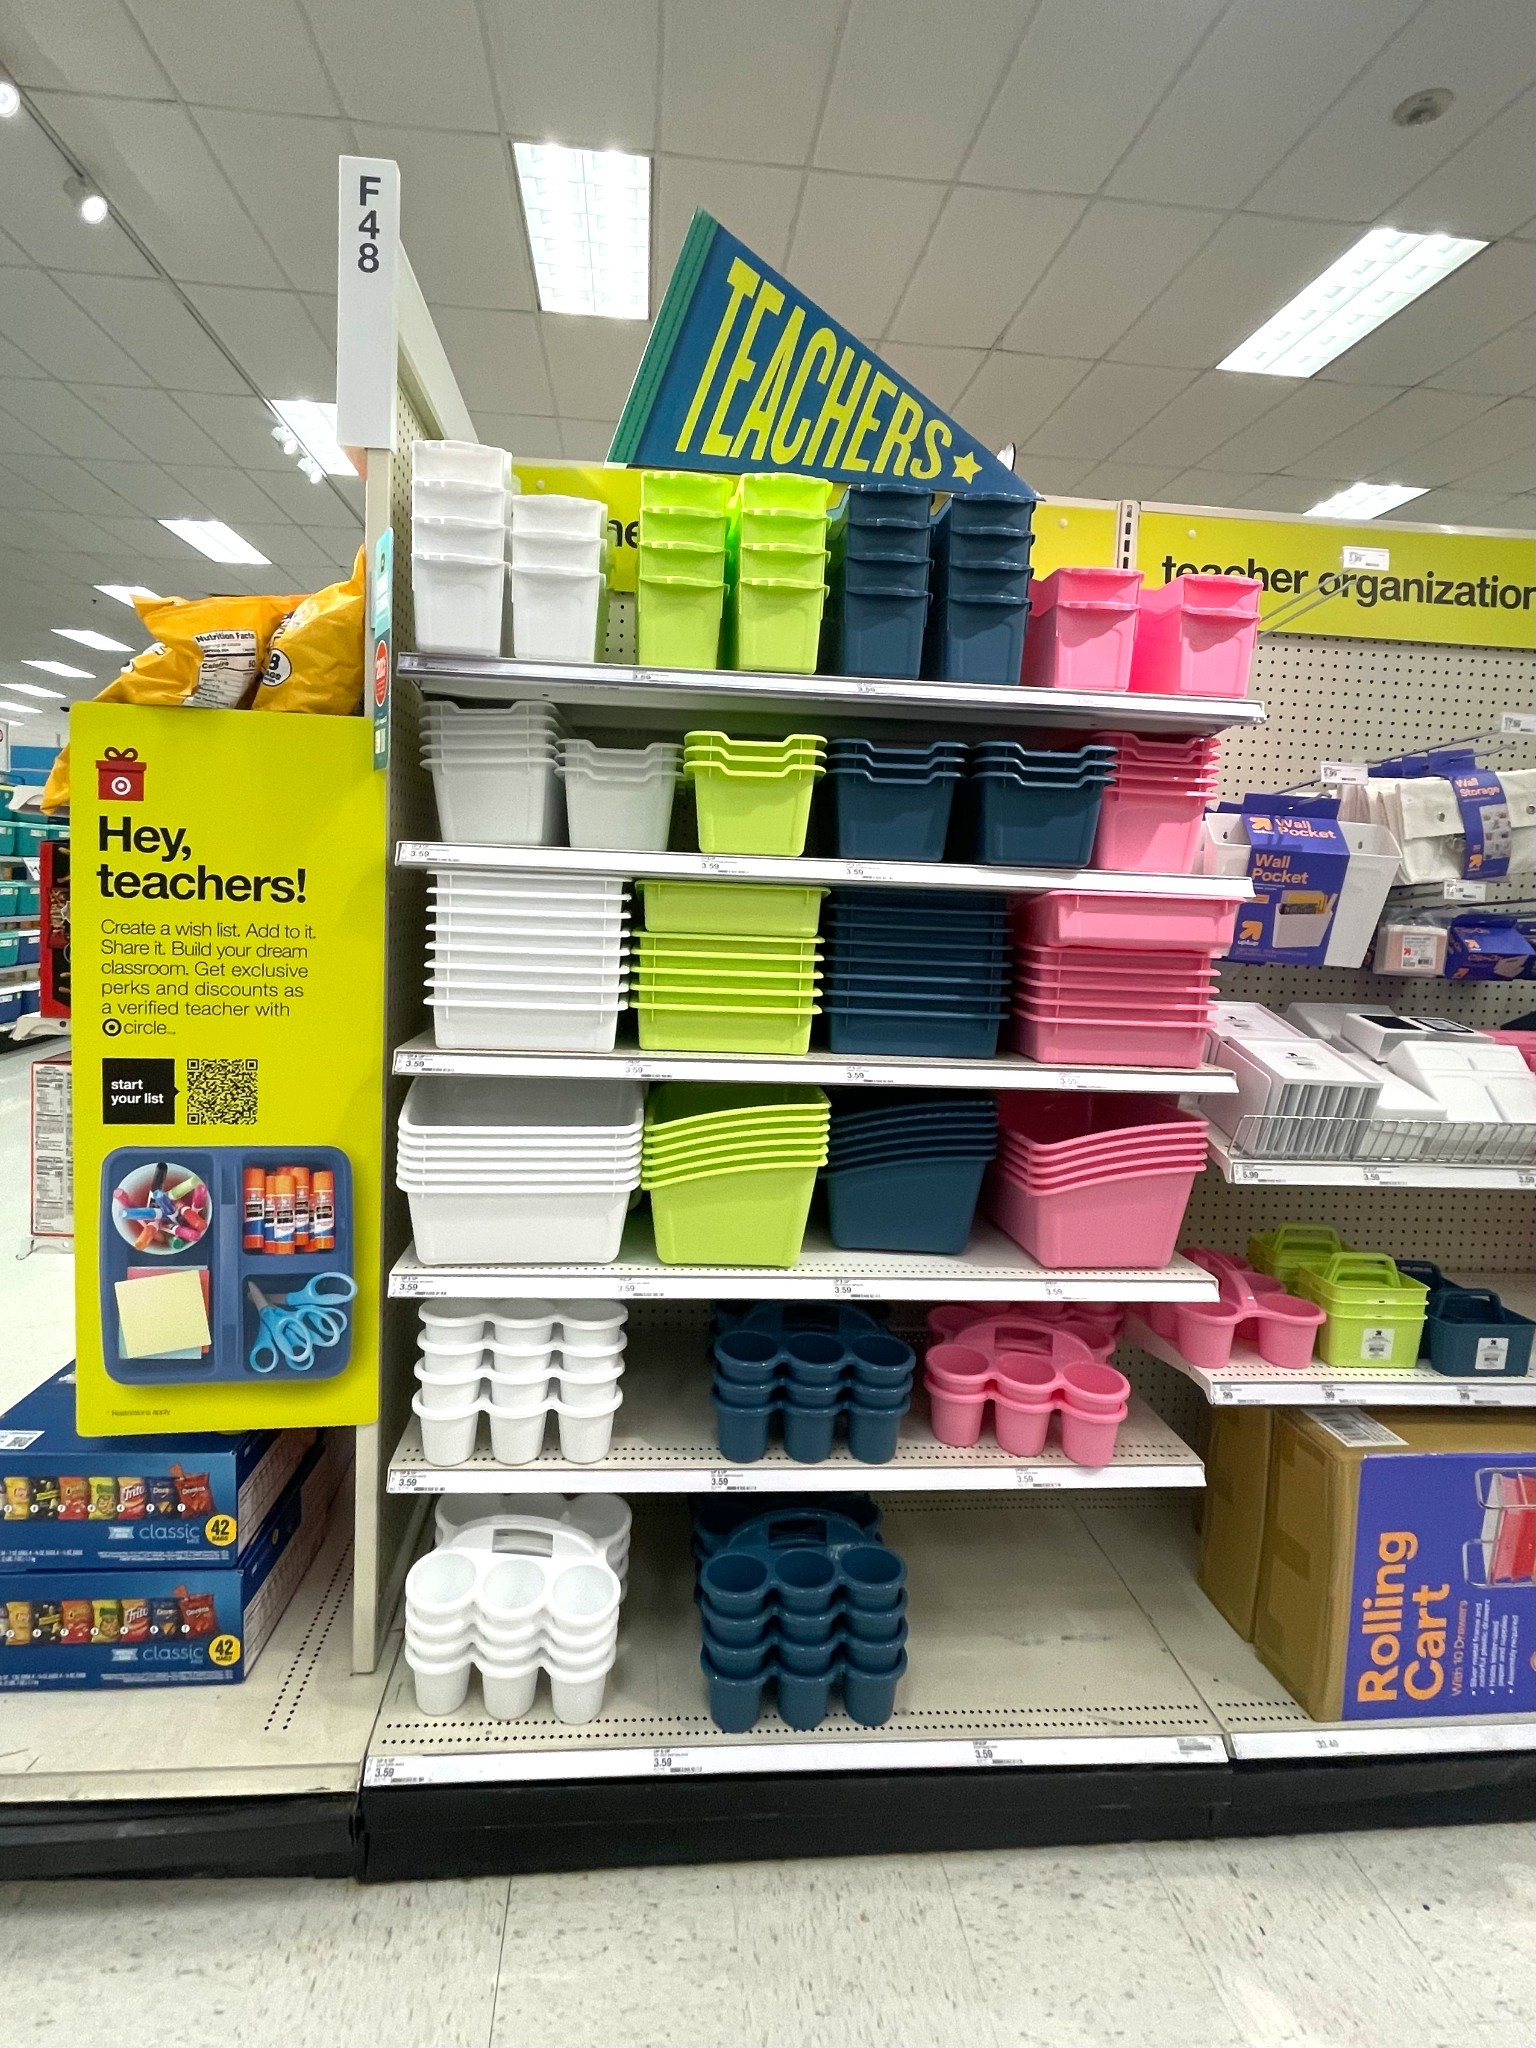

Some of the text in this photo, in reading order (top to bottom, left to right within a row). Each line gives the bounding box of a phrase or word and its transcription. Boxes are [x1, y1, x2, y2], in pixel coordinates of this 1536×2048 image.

[675, 256, 953, 480] TEACHERS
[1319, 569, 1536, 611] organization
[195, 632, 255, 643] Nutrition Facts
[1459, 787, 1500, 797] Storage
[1275, 817, 1311, 829] Wall
[98, 815, 192, 862] Hey,
[1277, 826, 1337, 839] Pocket
[1255, 853, 1291, 868] Wall
[96, 863, 307, 904] teachers!
[1252, 867, 1309, 884] Pocket
[101, 918, 317, 940] Create a wish list. Add to it.
[101, 939, 308, 960] Share it. Build your dream
[101, 960, 308, 979] classroom. Get exclusive
[101, 980, 304, 998] perks and discounts as
[101, 1000, 291, 1017] a verified teacher with
[111, 1079, 143, 1091] start
[111, 1092, 164, 1106] your list
[399, 1283, 418, 1291] 3.59
[834, 1286, 851, 1294] 3.59
[398, 1478, 417, 1487] 3.59
[711, 1477, 728, 1486] 3.59
[1016, 1475, 1033, 1483] 3.59
[139, 1523, 200, 1540] classic
[211, 1519, 230, 1536] 42
[1357, 1531, 1419, 1703] Rolling
[215, 1639, 234, 1656] 42
[1403, 1584, 1450, 1701] Cart
[1451, 1600, 1469, 1697] With 10 Drawers
[143, 1644, 203, 1661] classic
[654, 1757, 672, 1767] 3.59
[975, 1749, 993, 1759] 3.59
[375, 1767, 395, 1777] 3.59
